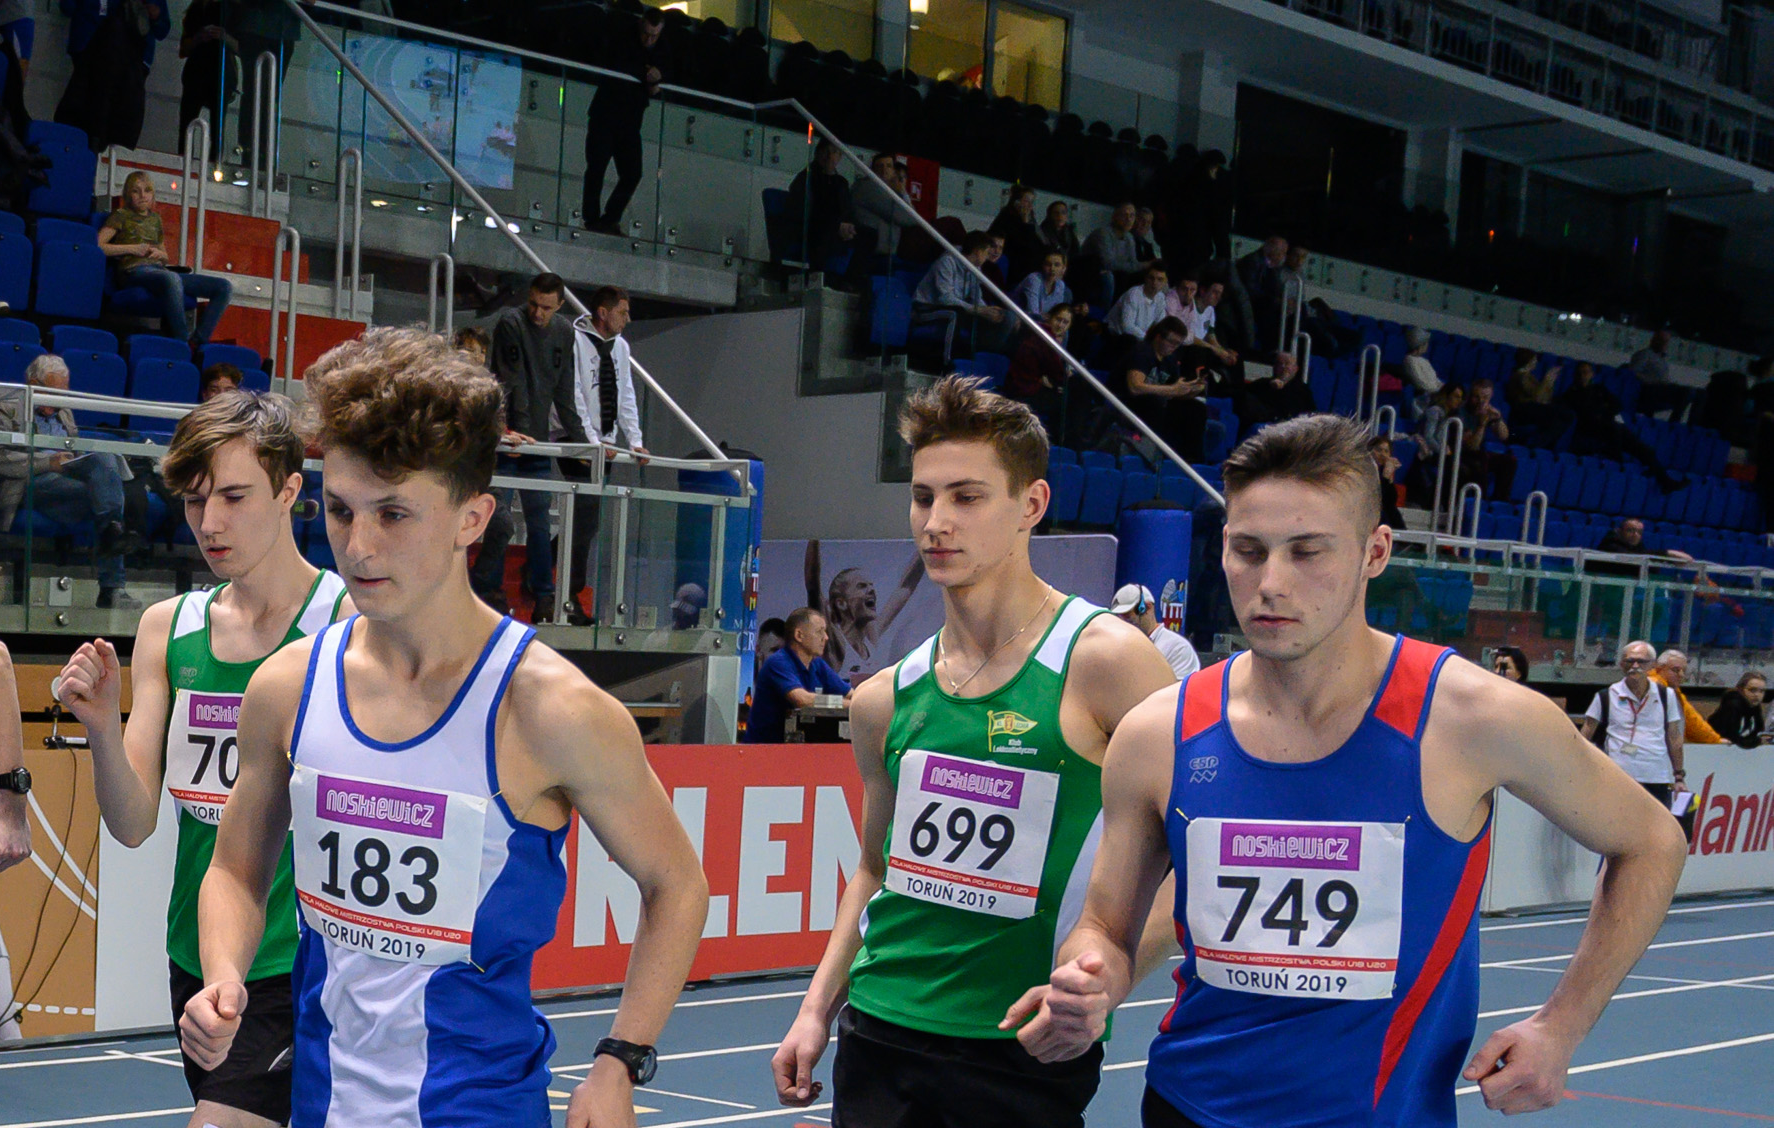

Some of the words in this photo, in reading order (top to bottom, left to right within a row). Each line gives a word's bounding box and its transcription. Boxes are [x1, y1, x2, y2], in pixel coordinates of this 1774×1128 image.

[195, 703, 240, 723] noskie
[187, 733, 240, 790] 70
[929, 766, 1014, 800] noskiewicz
[192, 805, 224, 821] TORU
[326, 789, 435, 828] noskiewicz
[909, 801, 1016, 871] 699
[1232, 834, 1350, 861] noskiewicz
[317, 830, 440, 916] 183
[558, 785, 863, 948] RLEN
[906, 877, 954, 901] TORUŃ
[957, 889, 997, 909] 2019
[339, 908, 394, 929] MISTRZOSTWA
[395, 923, 426, 934] POLSKI
[1217, 875, 1360, 948] 749
[321, 917, 374, 950] TORUŃ
[380, 936, 426, 959] 2019
[1248, 954, 1312, 966] MISTRZOSTWA
[1313, 958, 1345, 968] POLSKI
[1366, 960, 1386, 969] U20
[1226, 968, 1289, 990] TORUŃ
[1295, 974, 1347, 993] 2019
